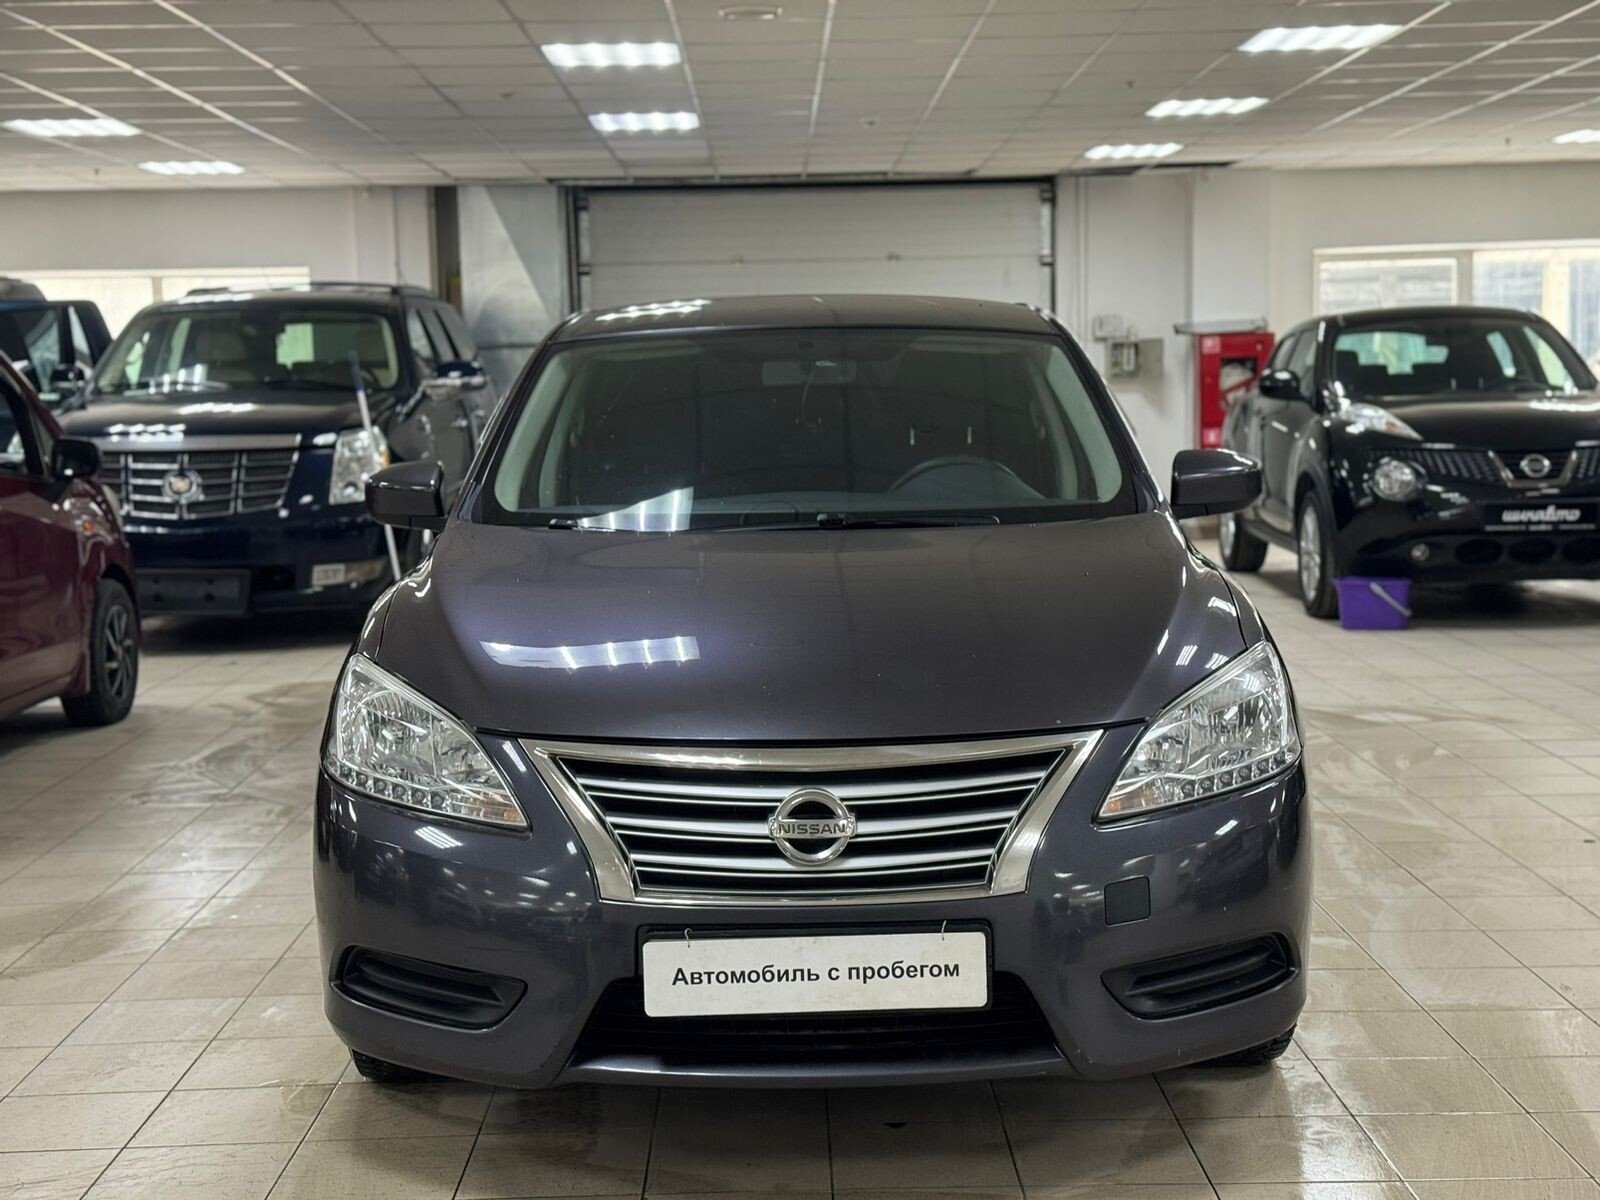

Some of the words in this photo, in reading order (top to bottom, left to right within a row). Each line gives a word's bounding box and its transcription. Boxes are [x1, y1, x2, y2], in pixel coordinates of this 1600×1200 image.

[778, 823, 846, 835] NISSAN
[672, 965, 819, 985] Автомобиль
[828, 968, 839, 980] с
[848, 961, 959, 984] пробегом
